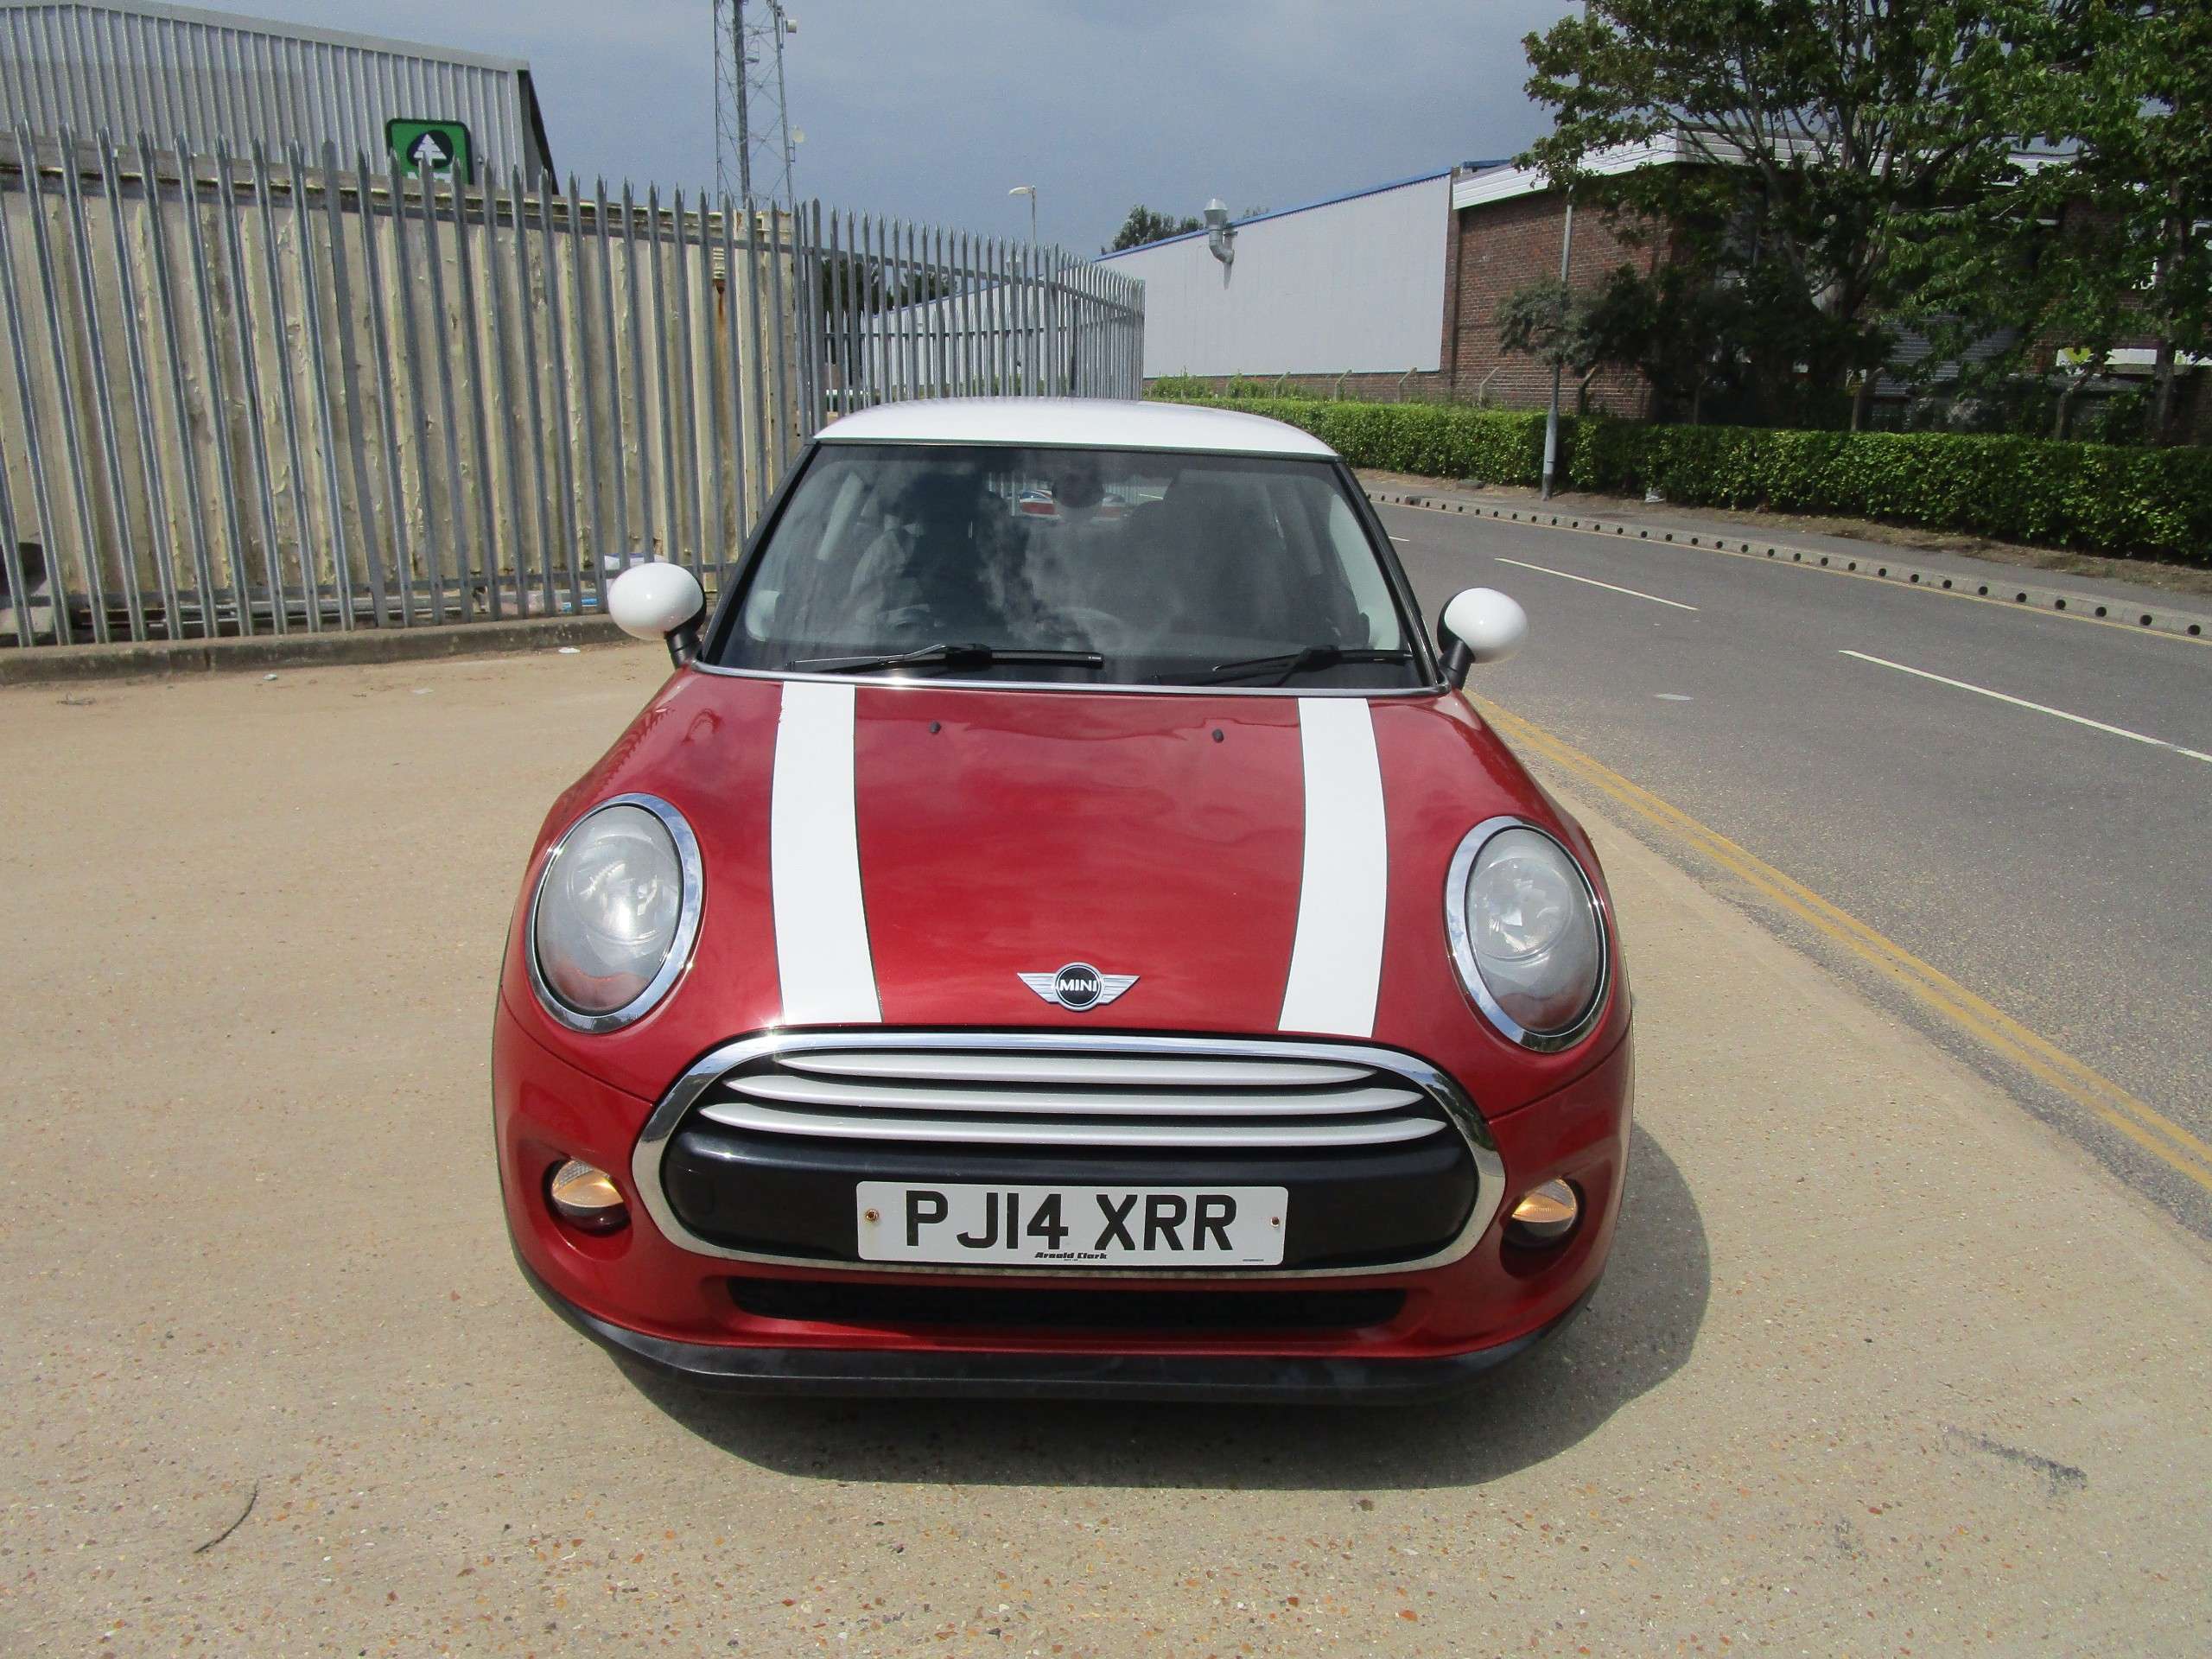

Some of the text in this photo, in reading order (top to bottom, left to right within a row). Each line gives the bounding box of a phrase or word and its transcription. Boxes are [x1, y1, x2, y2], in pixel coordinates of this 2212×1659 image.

[1059, 979, 1097, 992] MINI
[906, 1190, 1237, 1251] PJ14 XRR
